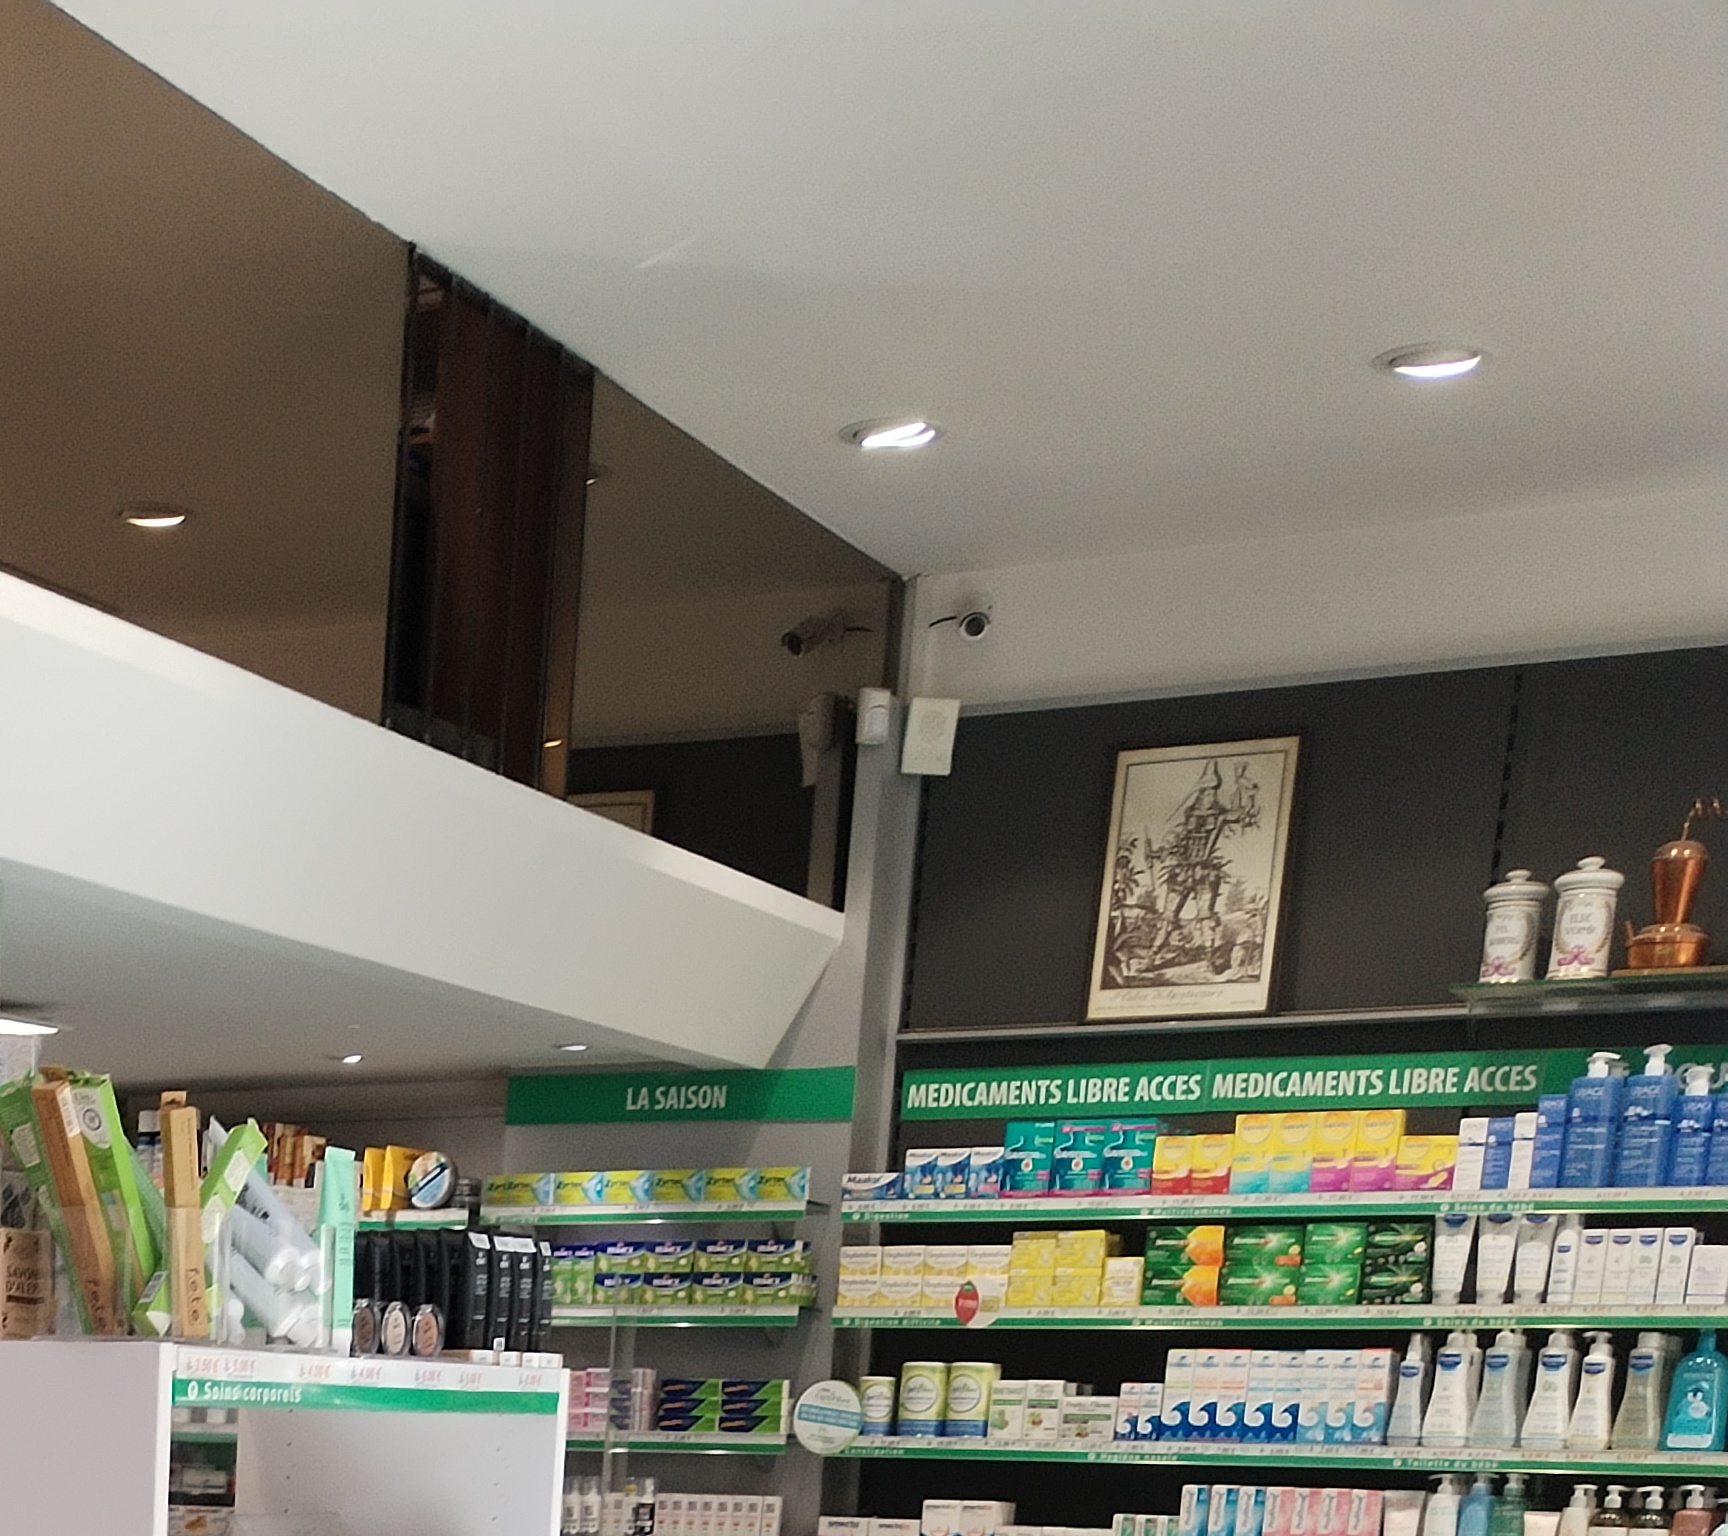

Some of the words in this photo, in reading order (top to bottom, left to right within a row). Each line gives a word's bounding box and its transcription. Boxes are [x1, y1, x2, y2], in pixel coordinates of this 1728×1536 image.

[626, 1087, 650, 1111] LA
[655, 1085, 727, 1110] SAISON
[907, 1080, 1062, 1108] MEDICAMENTS
[1067, 1077, 1129, 1103] LIBRE
[1134, 1074, 1202, 1101] ACCES
[1212, 1069, 1383, 1098] MEDICAMENTS
[1389, 1067, 1458, 1095] LIBRE
[1463, 1064, 1538, 1091] ACCES
[204, 1382, 239, 1400] Soins
[243, 1383, 302, 1404] corporels
